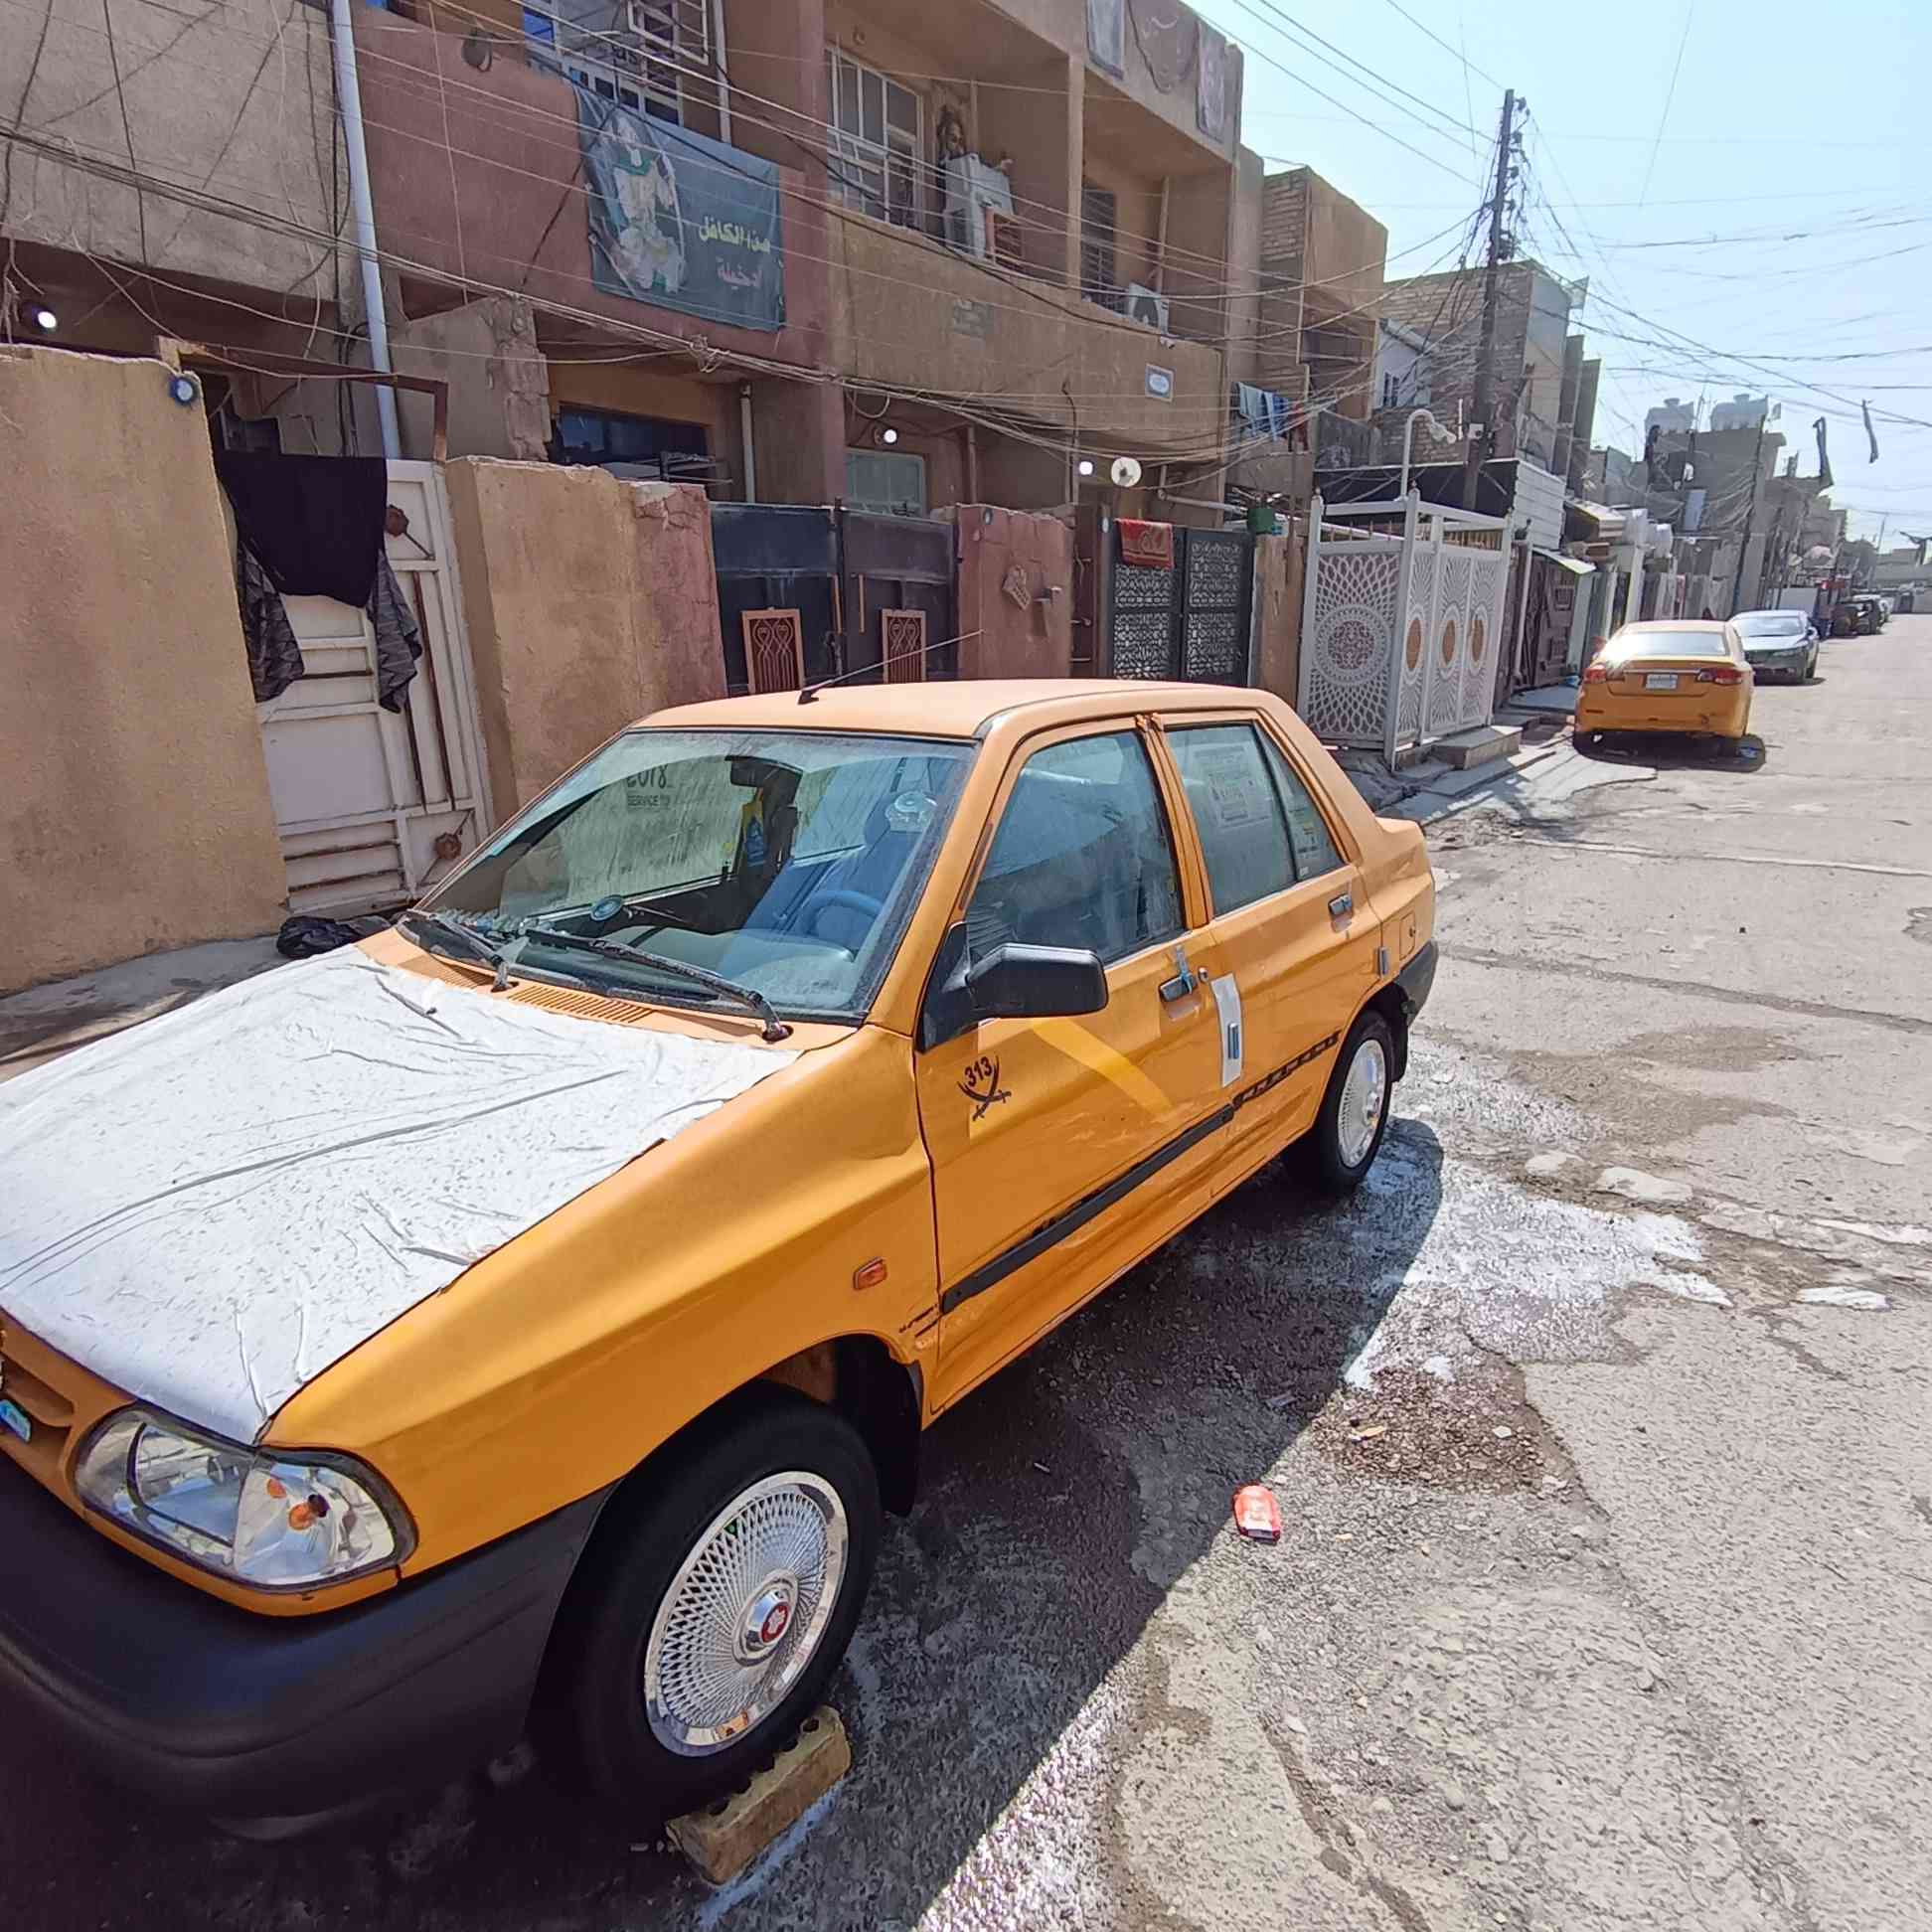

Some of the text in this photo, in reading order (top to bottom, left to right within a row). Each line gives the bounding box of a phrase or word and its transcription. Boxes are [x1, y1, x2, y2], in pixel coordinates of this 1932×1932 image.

[699, 216, 771, 254] هذا الكافل
[964, 1055, 993, 1087] 313
